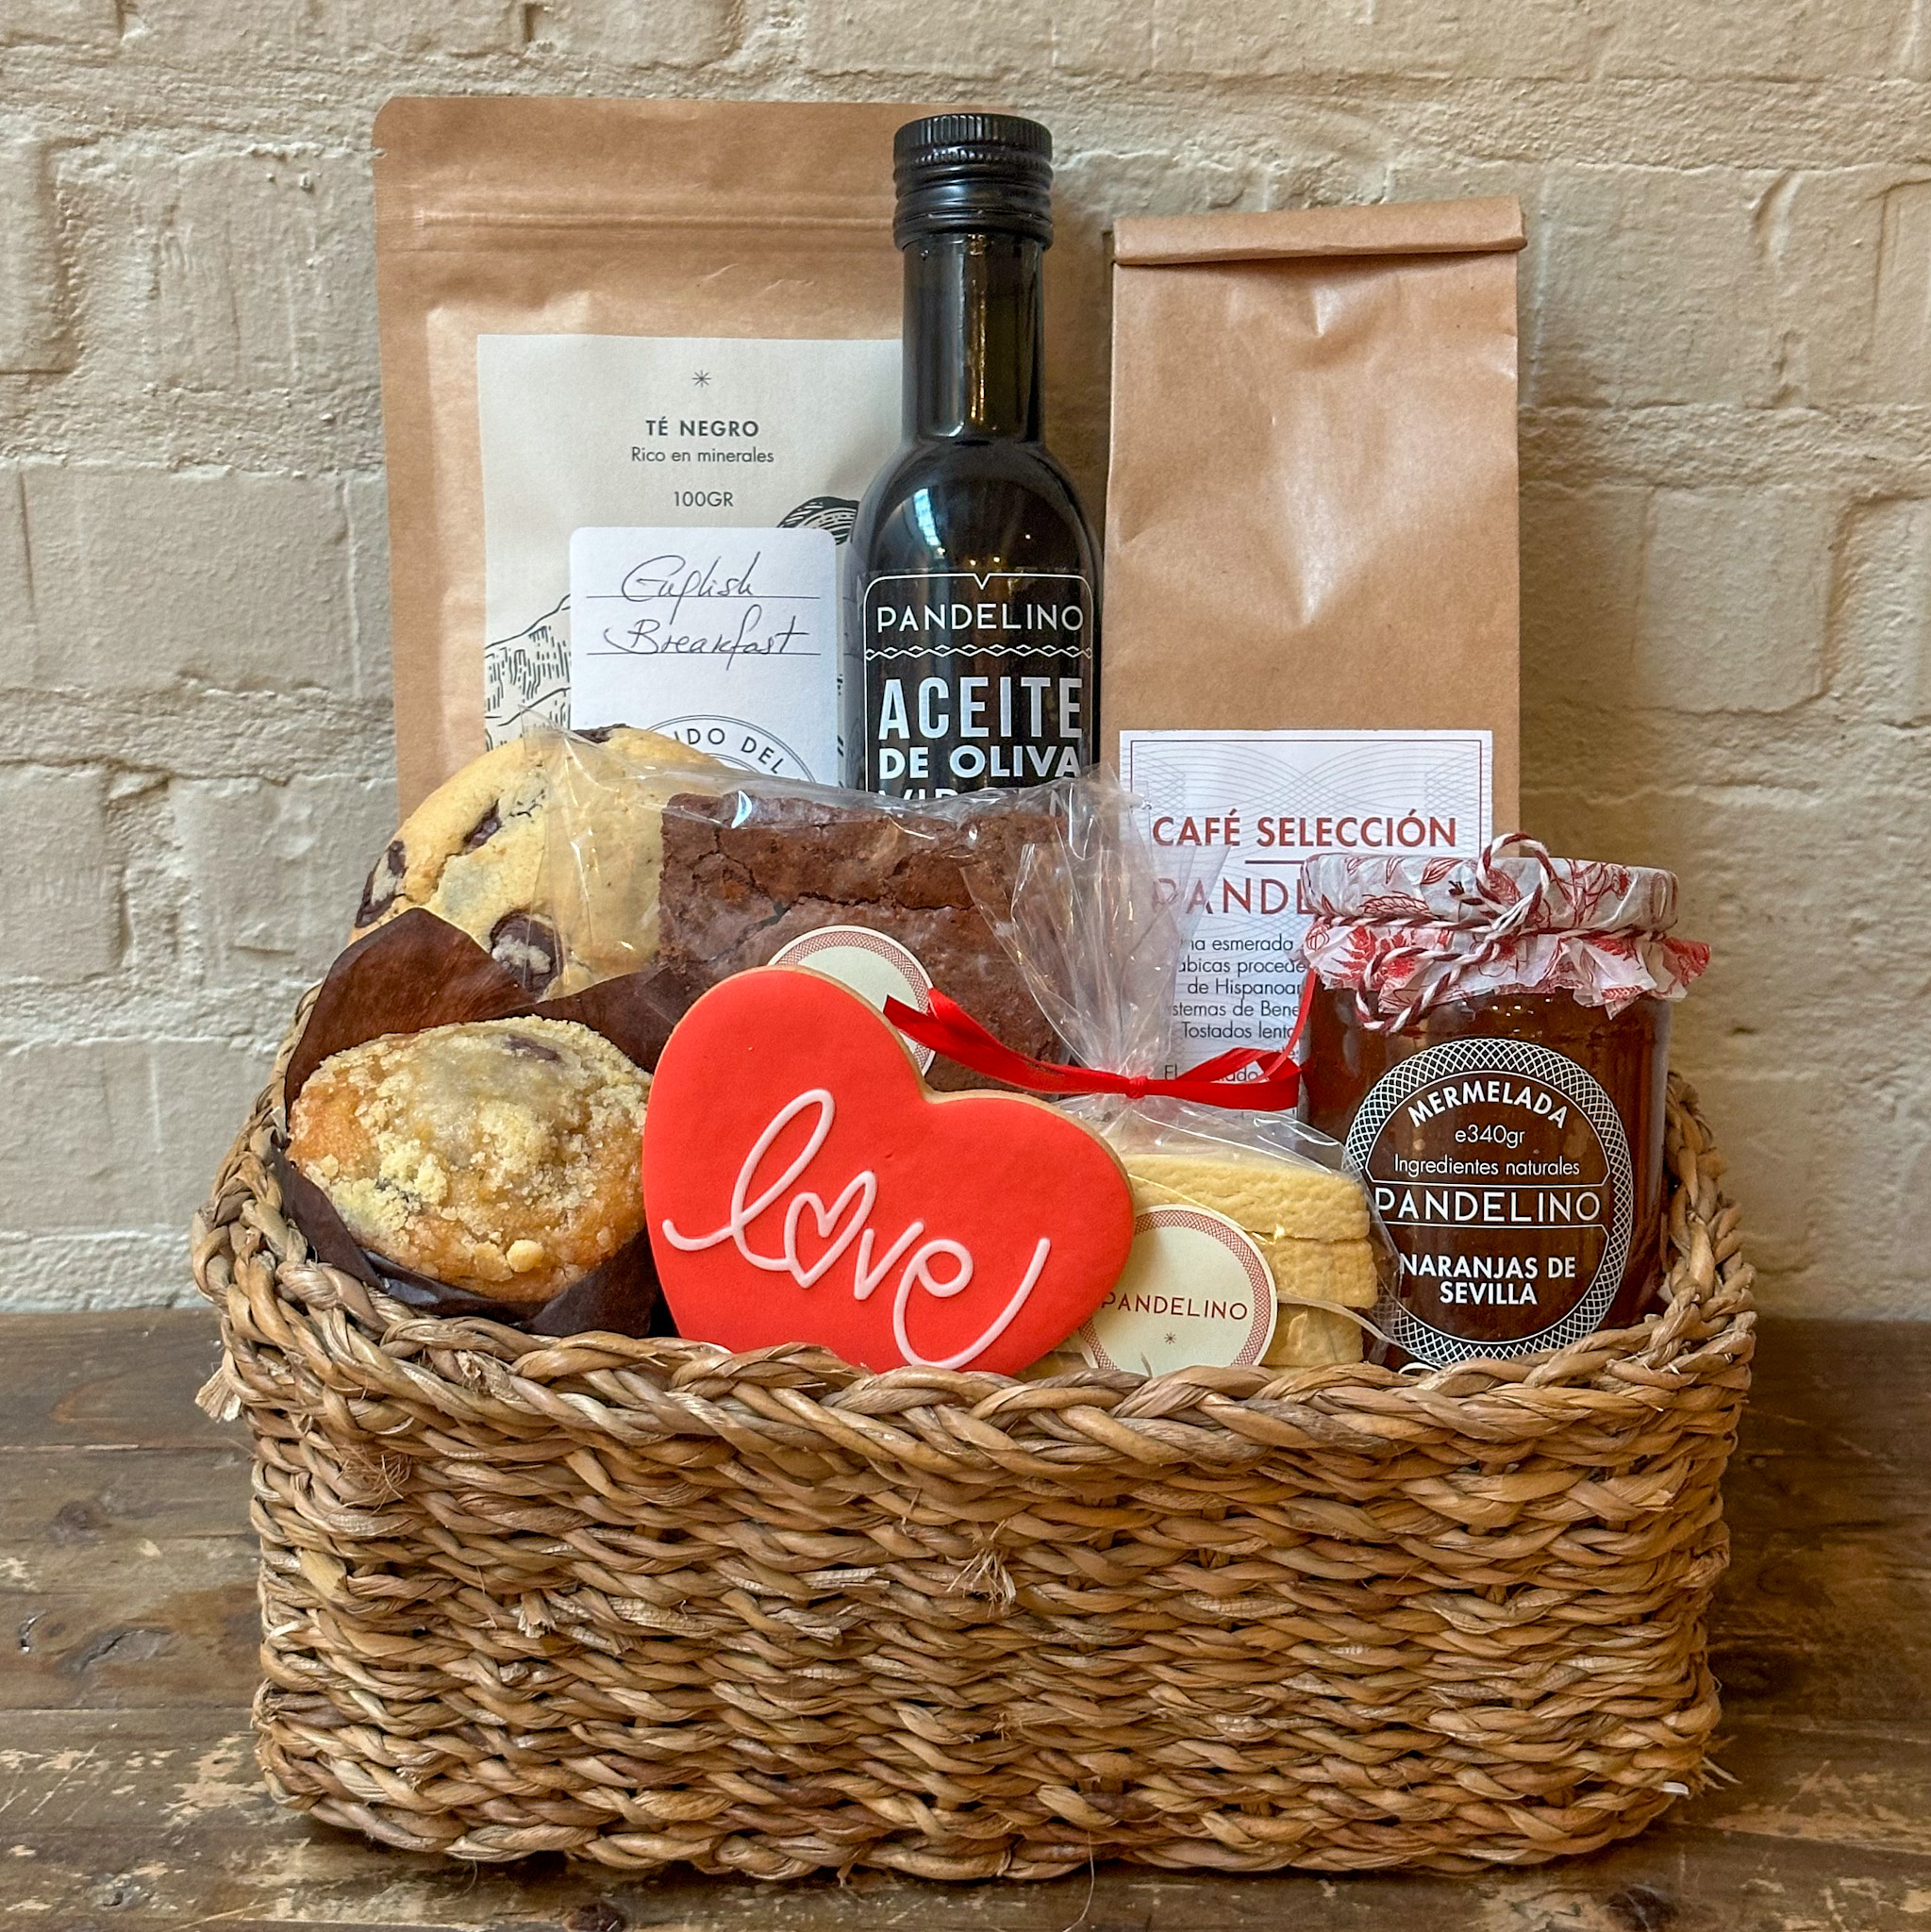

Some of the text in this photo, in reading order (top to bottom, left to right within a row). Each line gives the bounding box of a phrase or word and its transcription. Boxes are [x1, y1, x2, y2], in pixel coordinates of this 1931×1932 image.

[645, 416, 759, 437] TÉ NEGRO
[631, 447, 774, 463] Rico en minerales
[673, 491, 734, 508] 100GR
[876, 603, 1084, 633] PANDELINO
[604, 604, 810, 671] Breakfast
[877, 675, 1084, 741] ACEITE
[740, 735, 784, 774] DEL
[878, 744, 1081, 780] DE OLIVA
[1152, 808, 1457, 847] CAFÉ SELECCIÓN
[1211, 933, 1294, 952] esmerada
[1187, 976, 1209, 994] de
[1172, 1002, 1226, 1017] stemas
[1232, 999, 1254, 1017] de
[1181, 1021, 1252, 1039] Tostados
[1407, 1080, 1569, 1129] MERMELADA
[1455, 1124, 1525, 1149] e340gr
[1394, 1154, 1580, 1177] Ingredientes naturales
[1374, 1187, 1601, 1223] PANDELINO
[662, 1089, 1051, 1370] love
[1400, 1253, 1576, 1278] NARANJAS DE
[1440, 1281, 1539, 1305] SEVILLA
[1101, 1291, 1248, 1321] PANDELINO
